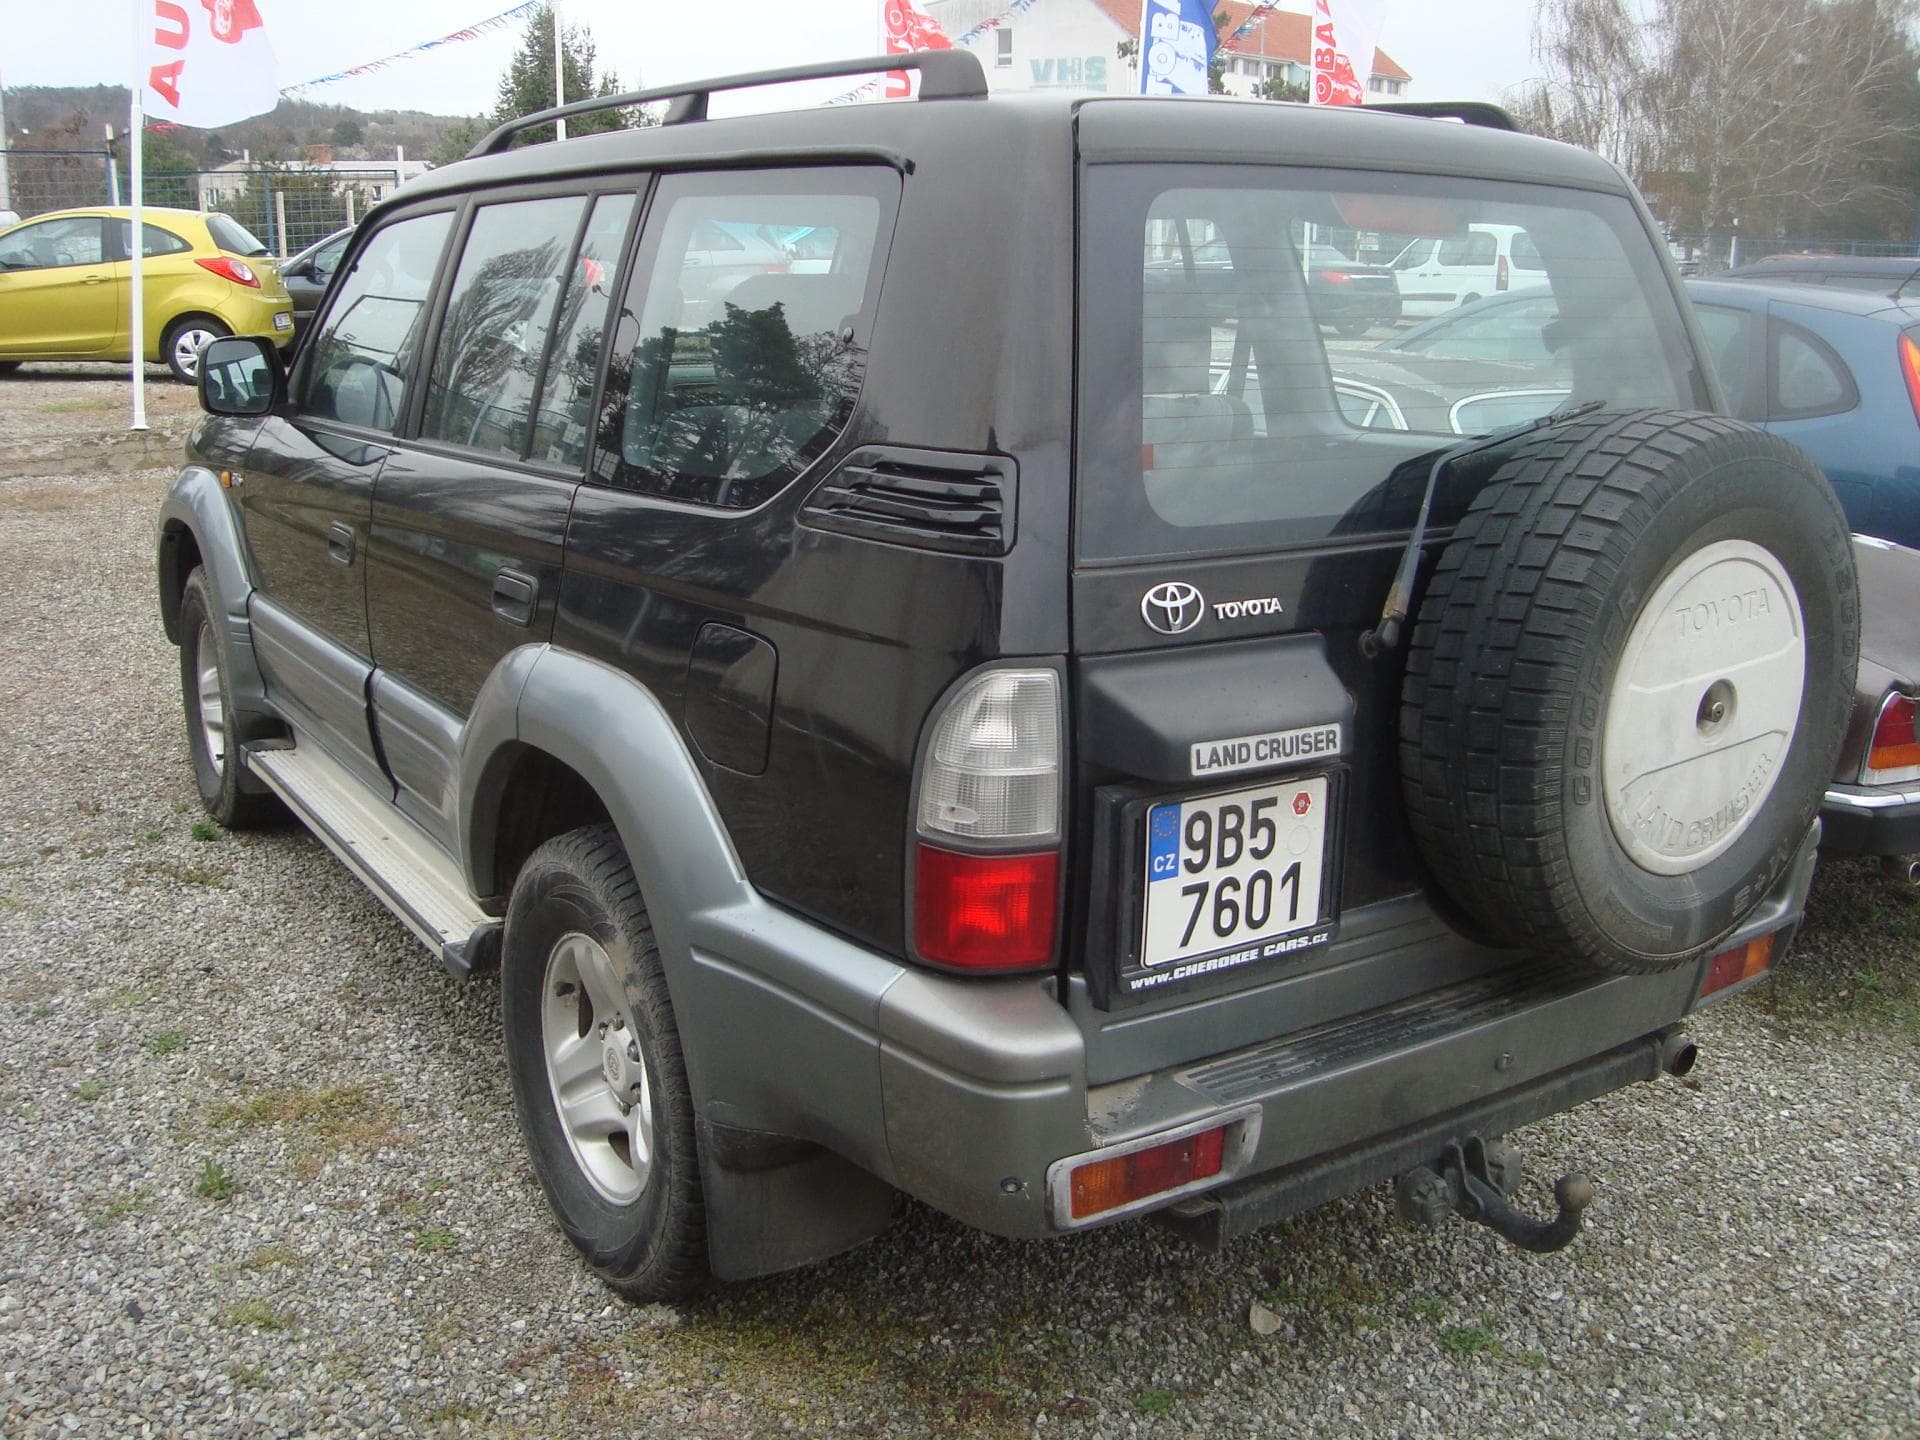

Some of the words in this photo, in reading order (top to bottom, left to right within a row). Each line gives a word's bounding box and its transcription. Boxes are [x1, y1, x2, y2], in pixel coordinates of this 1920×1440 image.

[1029, 56, 1106, 82] VHS
[1213, 597, 1283, 620] TOYOTA
[1675, 588, 1772, 638] TOYOTA
[1196, 743, 1251, 771] LAND
[1254, 730, 1337, 762] CRUISER
[1183, 797, 1279, 875] 9B5
[1154, 853, 1176, 873] CZ
[1179, 861, 1302, 948] 7601
